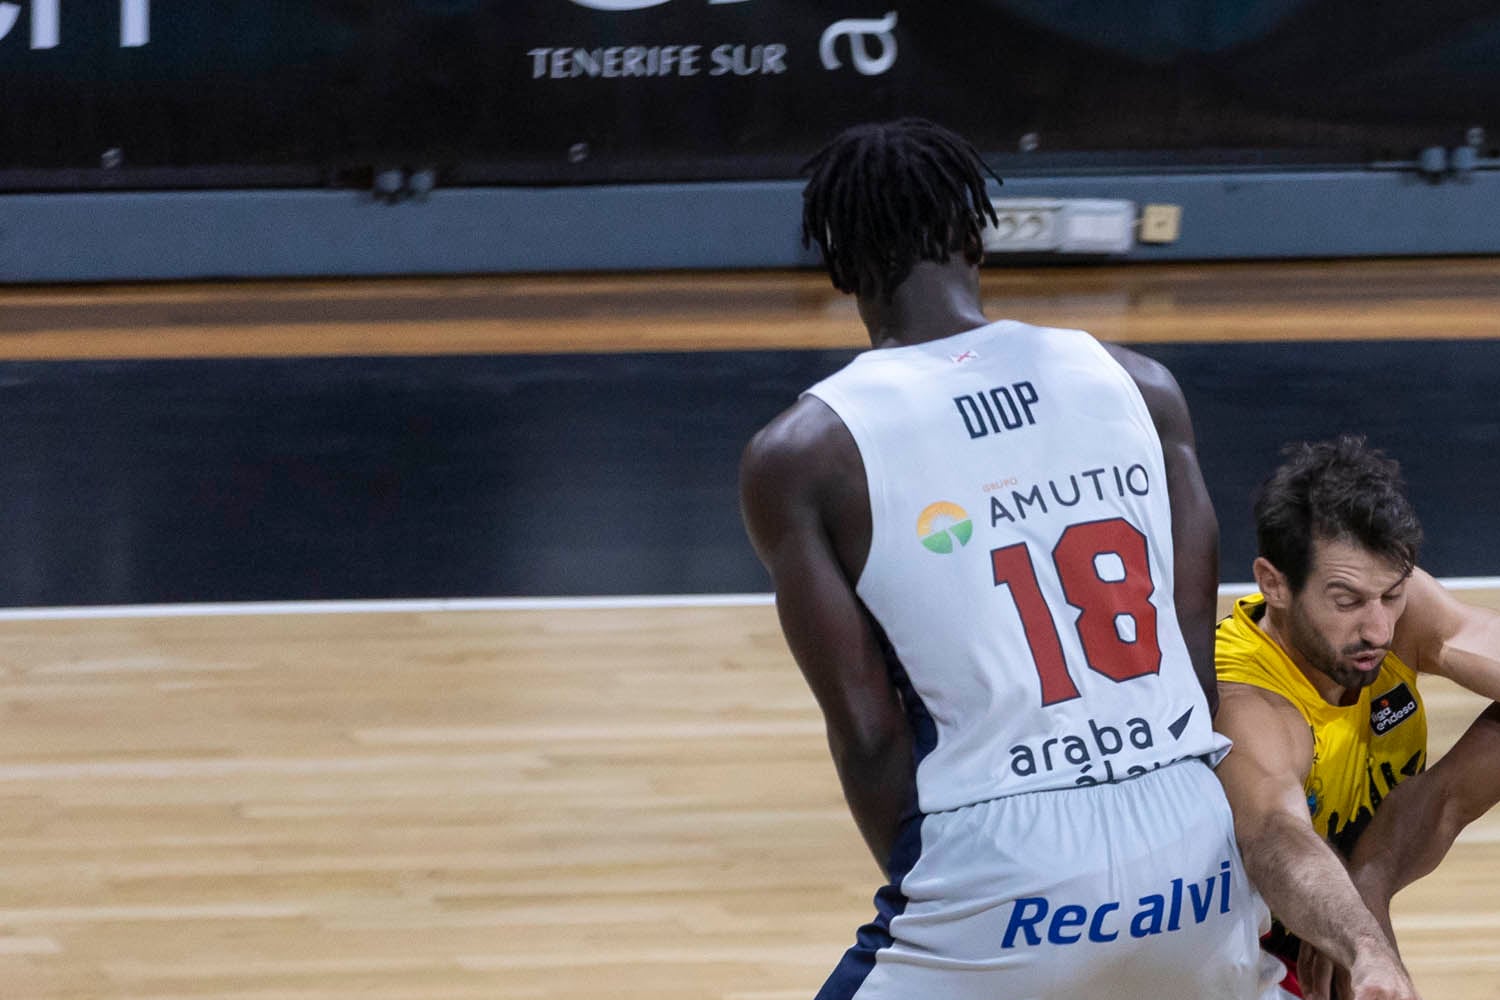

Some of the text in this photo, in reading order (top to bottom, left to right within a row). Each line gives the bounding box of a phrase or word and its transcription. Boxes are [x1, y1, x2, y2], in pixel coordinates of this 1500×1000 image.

[527, 44, 788, 79] TENERIFE SUR
[953, 381, 1039, 439] DIOP
[990, 463, 1149, 527] AMUTIO
[990, 517, 1162, 708] 18
[1377, 701, 1415, 731] endesa
[1009, 717, 1154, 777] araba
[1001, 860, 1231, 949] Recalvi
